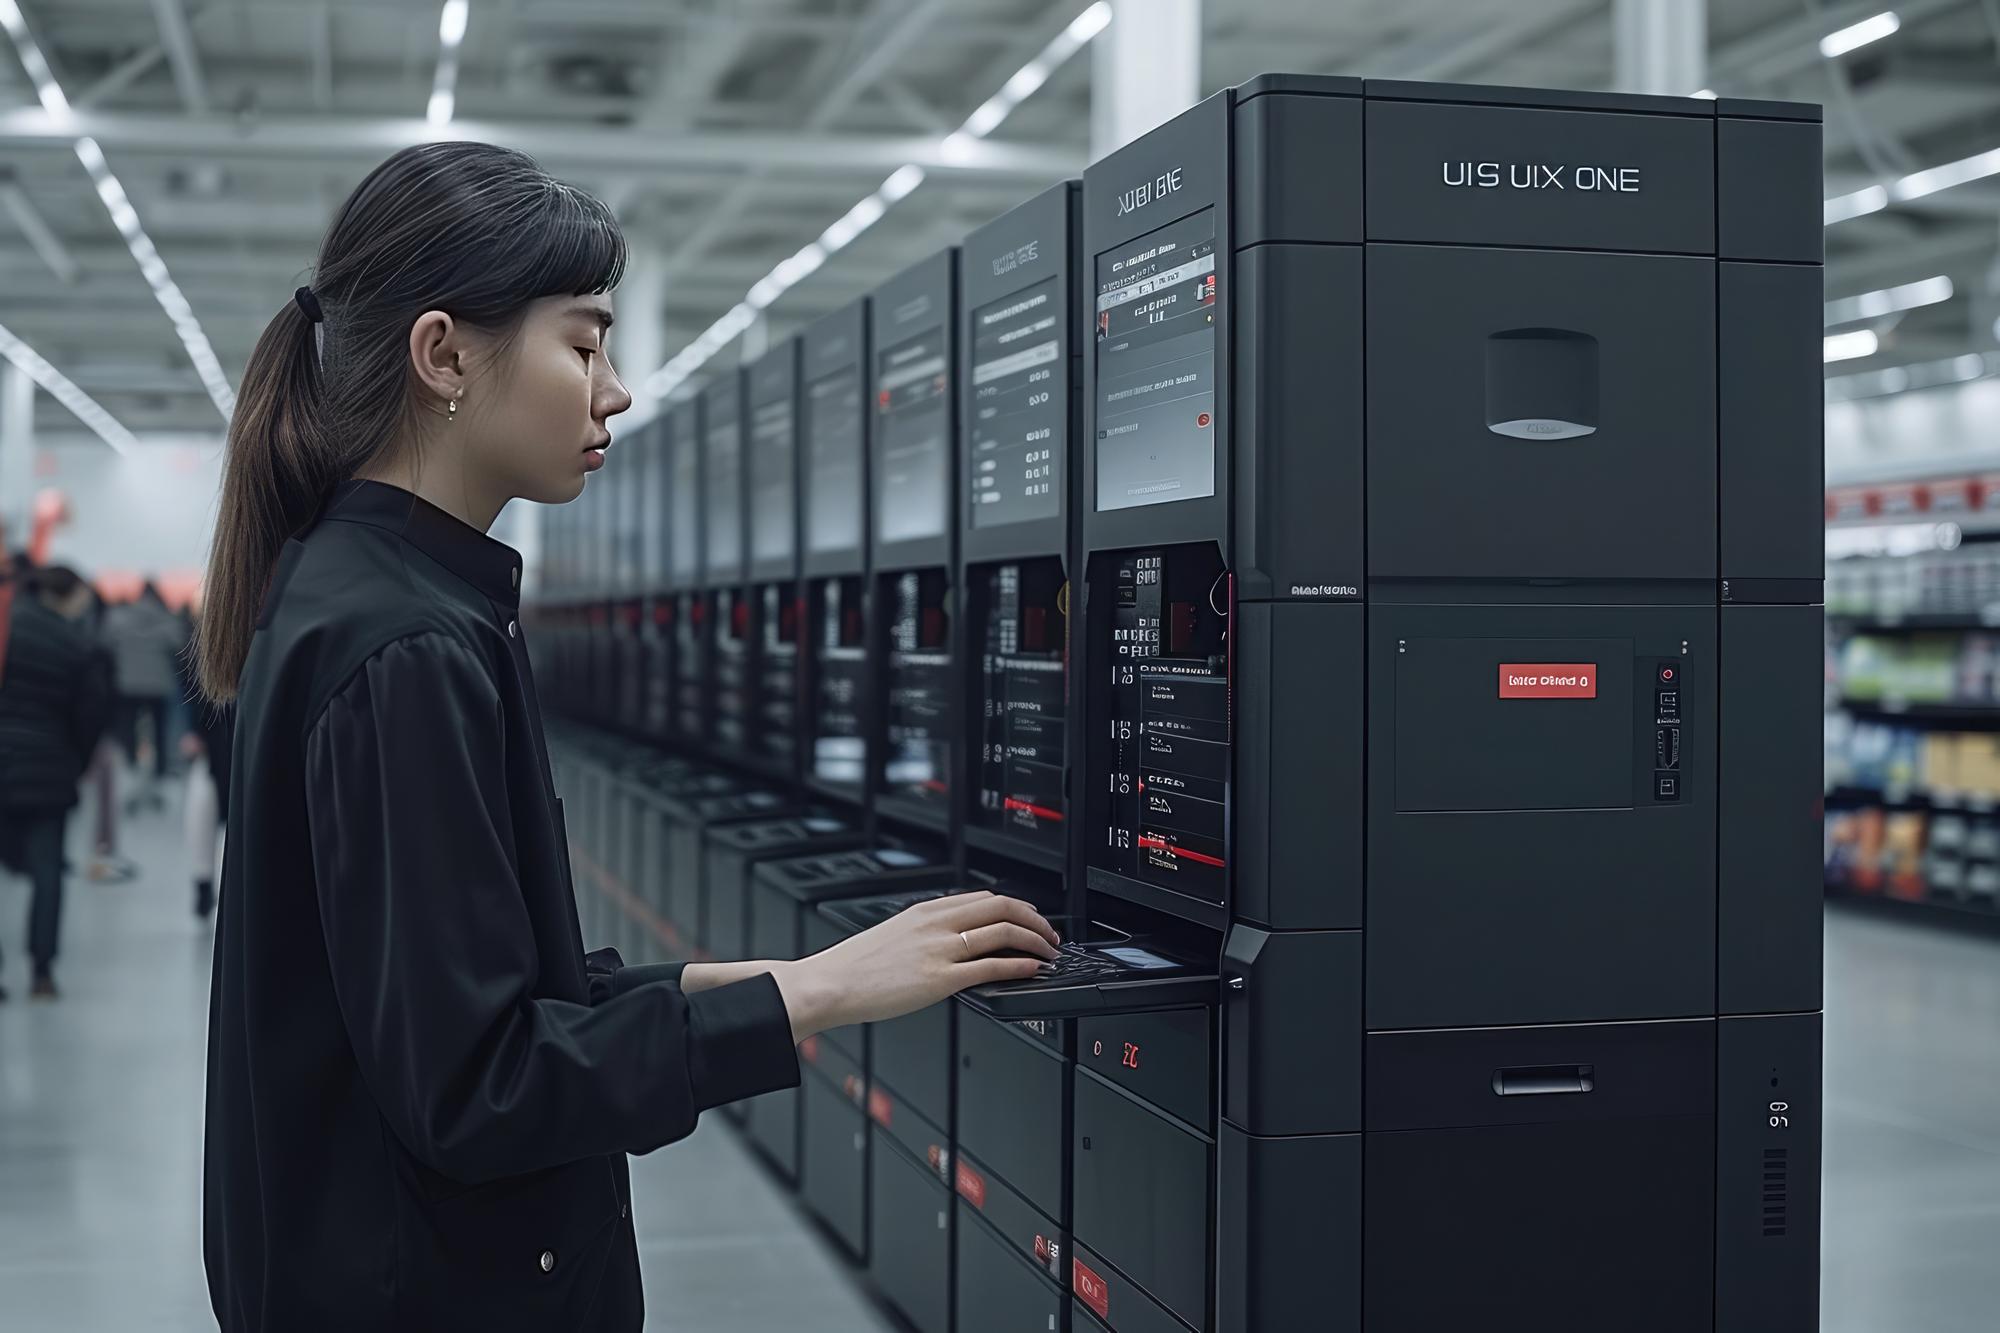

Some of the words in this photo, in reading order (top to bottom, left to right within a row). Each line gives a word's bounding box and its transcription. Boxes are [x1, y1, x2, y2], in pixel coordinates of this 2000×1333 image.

[1443, 162, 1500, 187] UIS
[1510, 165, 1565, 189] UIX
[1575, 167, 1640, 192] ONE
